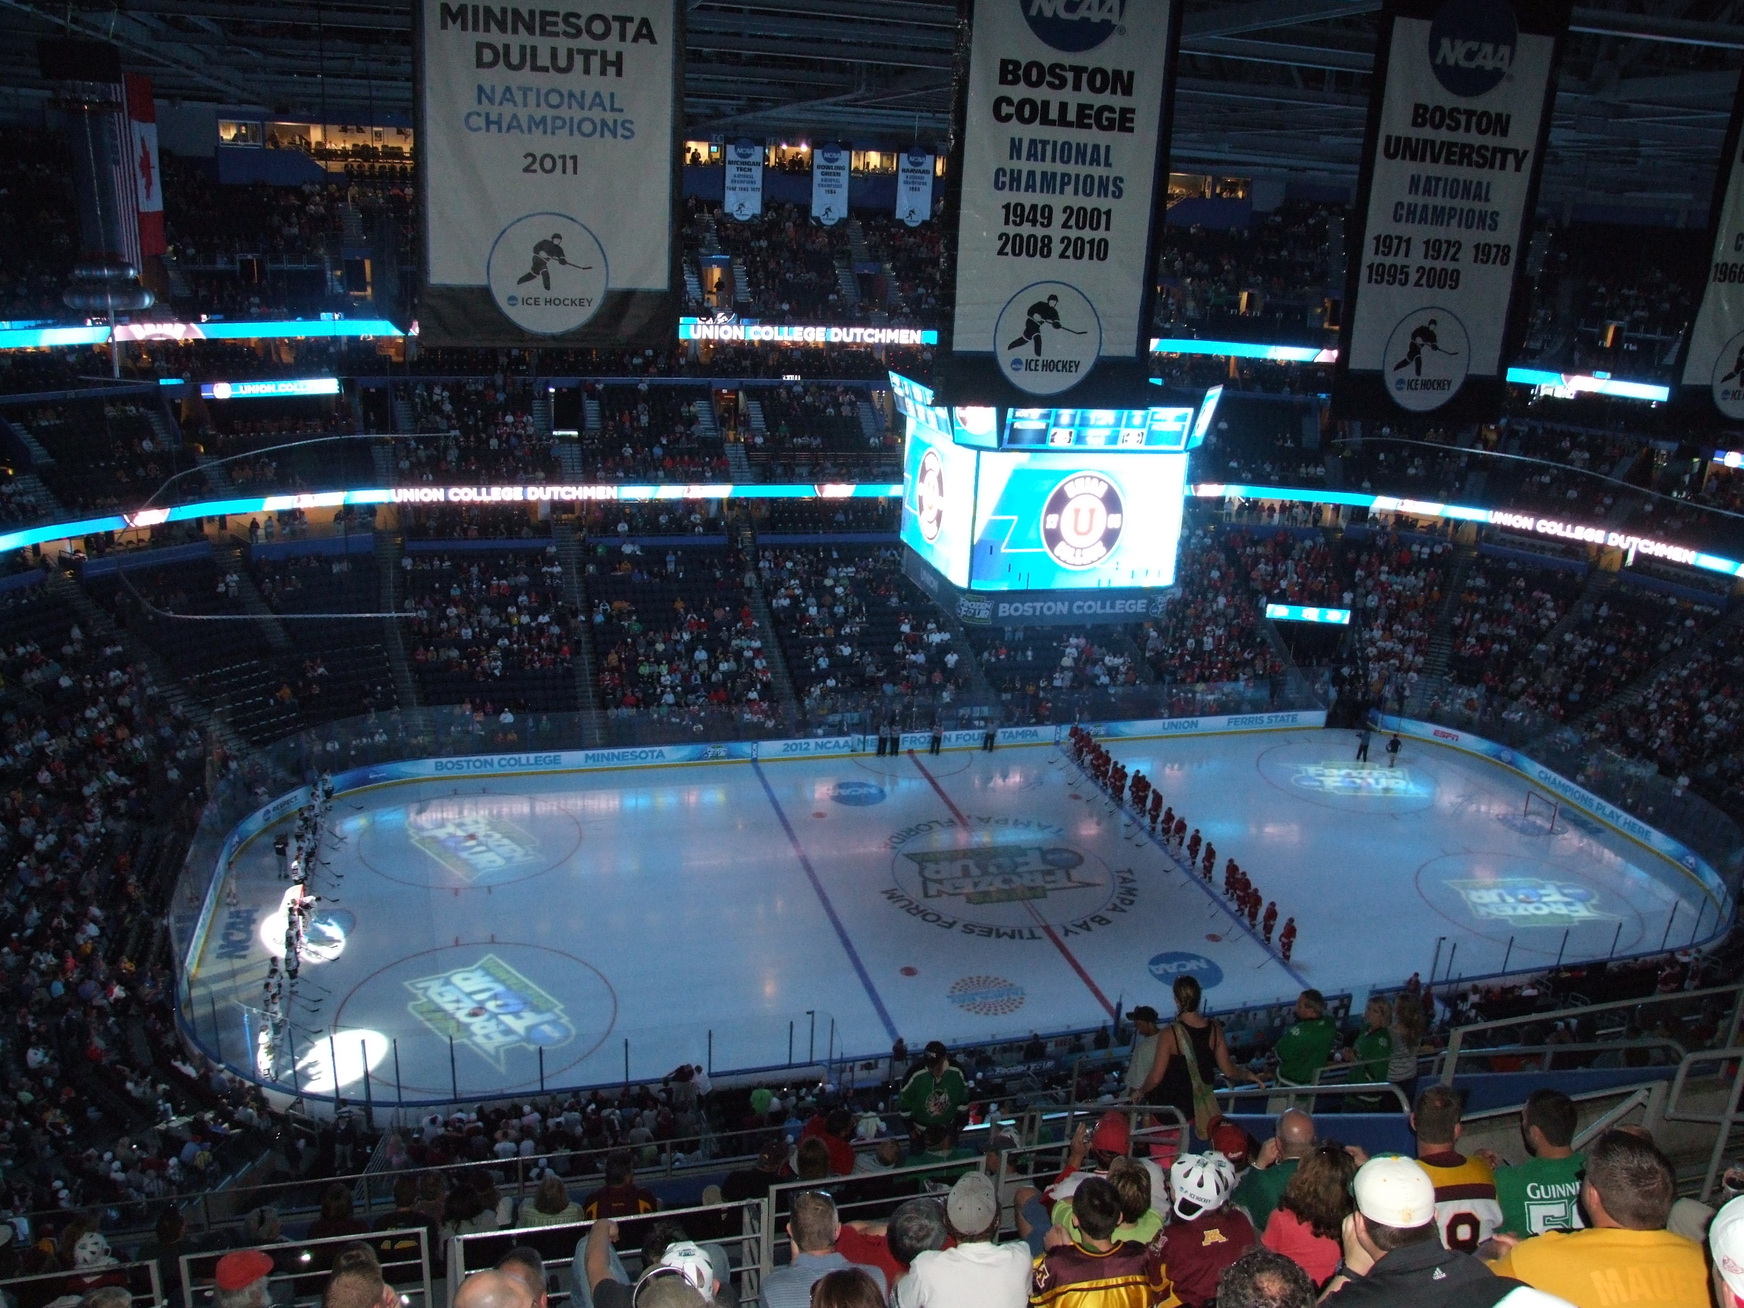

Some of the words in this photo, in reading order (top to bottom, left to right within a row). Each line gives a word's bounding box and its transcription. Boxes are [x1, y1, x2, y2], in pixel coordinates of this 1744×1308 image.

[440, 2, 658, 45] MINNESOTA
[1027, 0, 1124, 26] NCAA
[475, 41, 623, 77] DULUTH
[1435, 37, 1513, 71] NCAA
[999, 58, 1135, 97] BOSTON
[476, 83, 625, 113] NATIONAL
[464, 110, 635, 140] CHAMPIONS
[992, 95, 1136, 133] COLLEGE
[1411, 102, 1511, 137] BOSTON
[522, 152, 578, 175] 2011
[1009, 136, 1112, 168] NATIONAL
[1383, 134, 1529, 173] UNIVERSITY
[993, 167, 1125, 199] CHAMPIONS
[1408, 173, 1491, 203] NATIONAL
[1002, 202, 1053, 228] 1949
[1062, 206, 1112, 231] 2001
[1393, 201, 1499, 232] CHAMPIONS
[997, 234, 1053, 259] 2008
[1059, 237, 1109, 261] 2010
[1373, 234, 1411, 259] 1971
[1422, 238, 1461, 263] 1972
[1473, 242, 1511, 267] 1978
[1366, 262, 1410, 287] 1995
[1413, 265, 1460, 290] 2009
[522, 297, 541, 307] ICE
[545, 297, 593, 308] HOCKEY
[690, 324, 745, 340] UNION
[749, 325, 826, 341] COLLEGE
[830, 327, 921, 344] DUTCHMEN
[1025, 358, 1040, 373] ICE
[1041, 359, 1080, 374] HOCKEY
[240, 384, 275, 394] UNION
[1407, 378, 1420, 391] ICE
[1420, 379, 1452, 392] HOCKEY
[391, 488, 444, 502] UNION
[448, 487, 523, 501] COLLEGE
[527, 486, 618, 500] DUTCHMEN
[1073, 508, 1096, 536] U
[1488, 510, 1534, 531] UNION
[1536, 519, 1606, 544] COLLEGE
[1608, 532, 1696, 565] DUTCHMEN
[960, 597, 992, 610] FROZEN
[961, 607, 990, 619] FOUR
[998, 601, 1069, 617] BOSTON
[1072, 600, 1147, 615] COLLEGE
[1163, 719, 1199, 731] UNION
[1227, 715, 1265, 727] FERRIS
[1267, 714, 1298, 725] STATE
[782, 741, 810, 753] 2012
[814, 740, 850, 752] NCAA
[901, 732, 951, 746] FROZN
[999, 729, 1039, 740] TAMPA
[1433, 729, 1459, 742] ESPN
[434, 758, 494, 772] BOSTON
[497, 754, 562, 768] COLLEGE
[584, 748, 666, 764] MINNESOTA
[272, 795, 298, 813] RESPECT
[1538, 770, 1594, 808] CHAMPIONS
[1595, 798, 1621, 823] PLAY
[1623, 817, 1652, 842] HERE
[1115, 867, 1139, 914] TAMPA
[881, 887, 958, 930] FORUM
[961, 922, 1043, 941] TIMES
[1063, 914, 1112, 938] BAY
